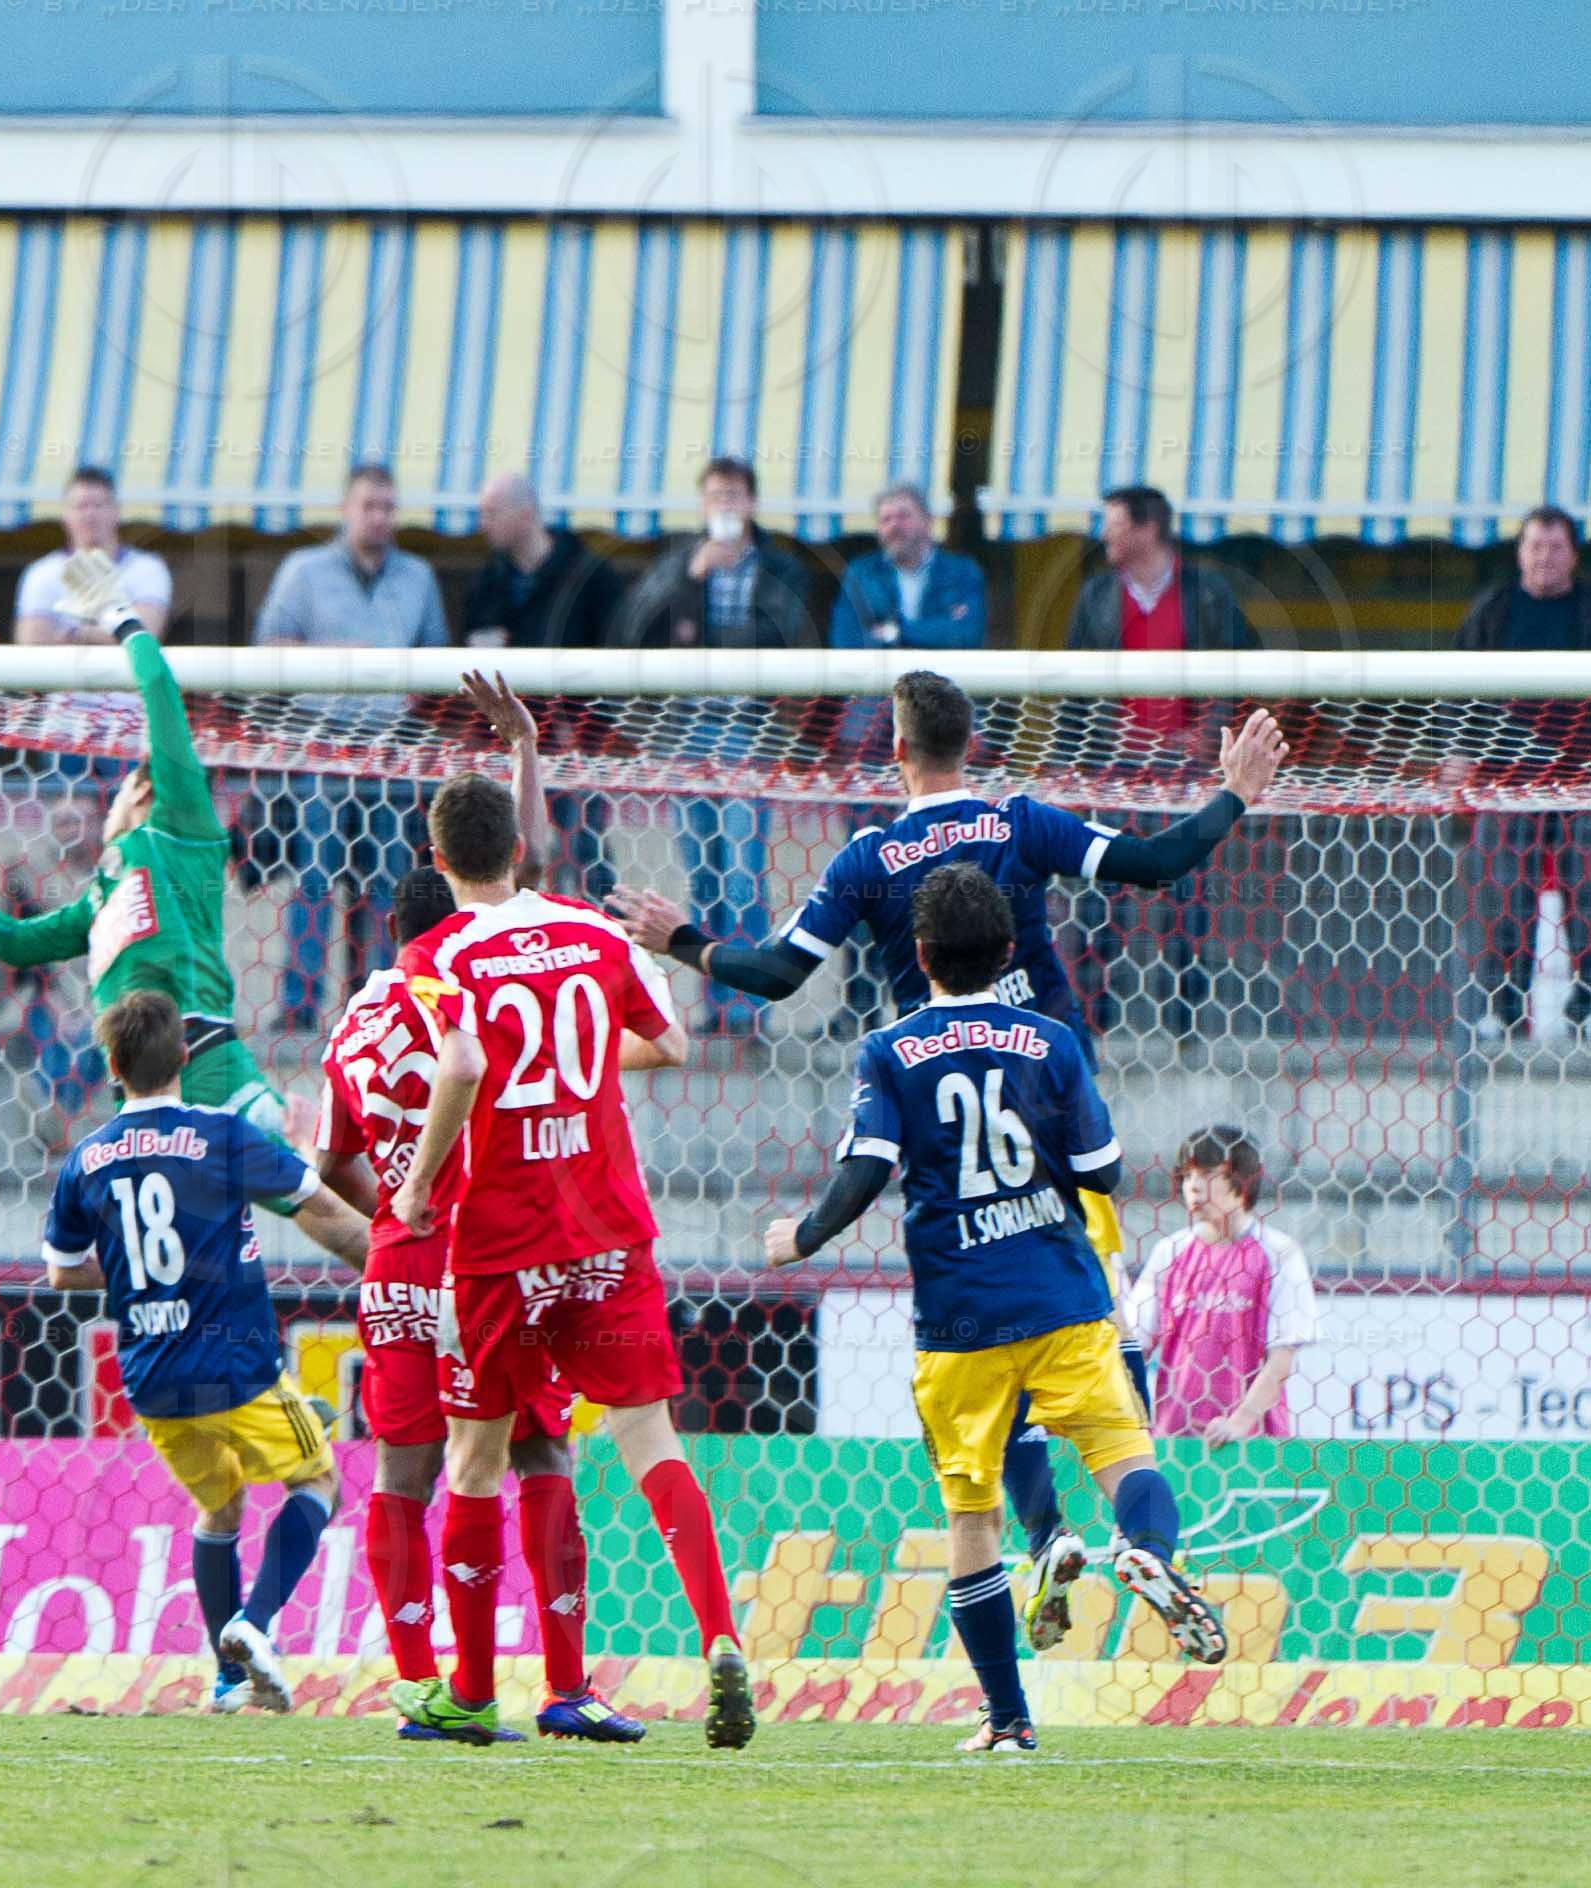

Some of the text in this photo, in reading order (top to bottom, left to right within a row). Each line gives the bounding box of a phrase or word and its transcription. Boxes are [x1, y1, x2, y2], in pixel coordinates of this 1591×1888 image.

[879, 826, 941, 875] Red
[486, 973, 610, 1109] 20
[892, 1021, 1050, 1069] Red Bulls
[81, 1126, 208, 1175] Red Bulls
[936, 1068, 1036, 1199] 26
[111, 1171, 186, 1291] 18
[360, 1281, 441, 1318] KLEIN
[1349, 1375, 1458, 1433] LPS
